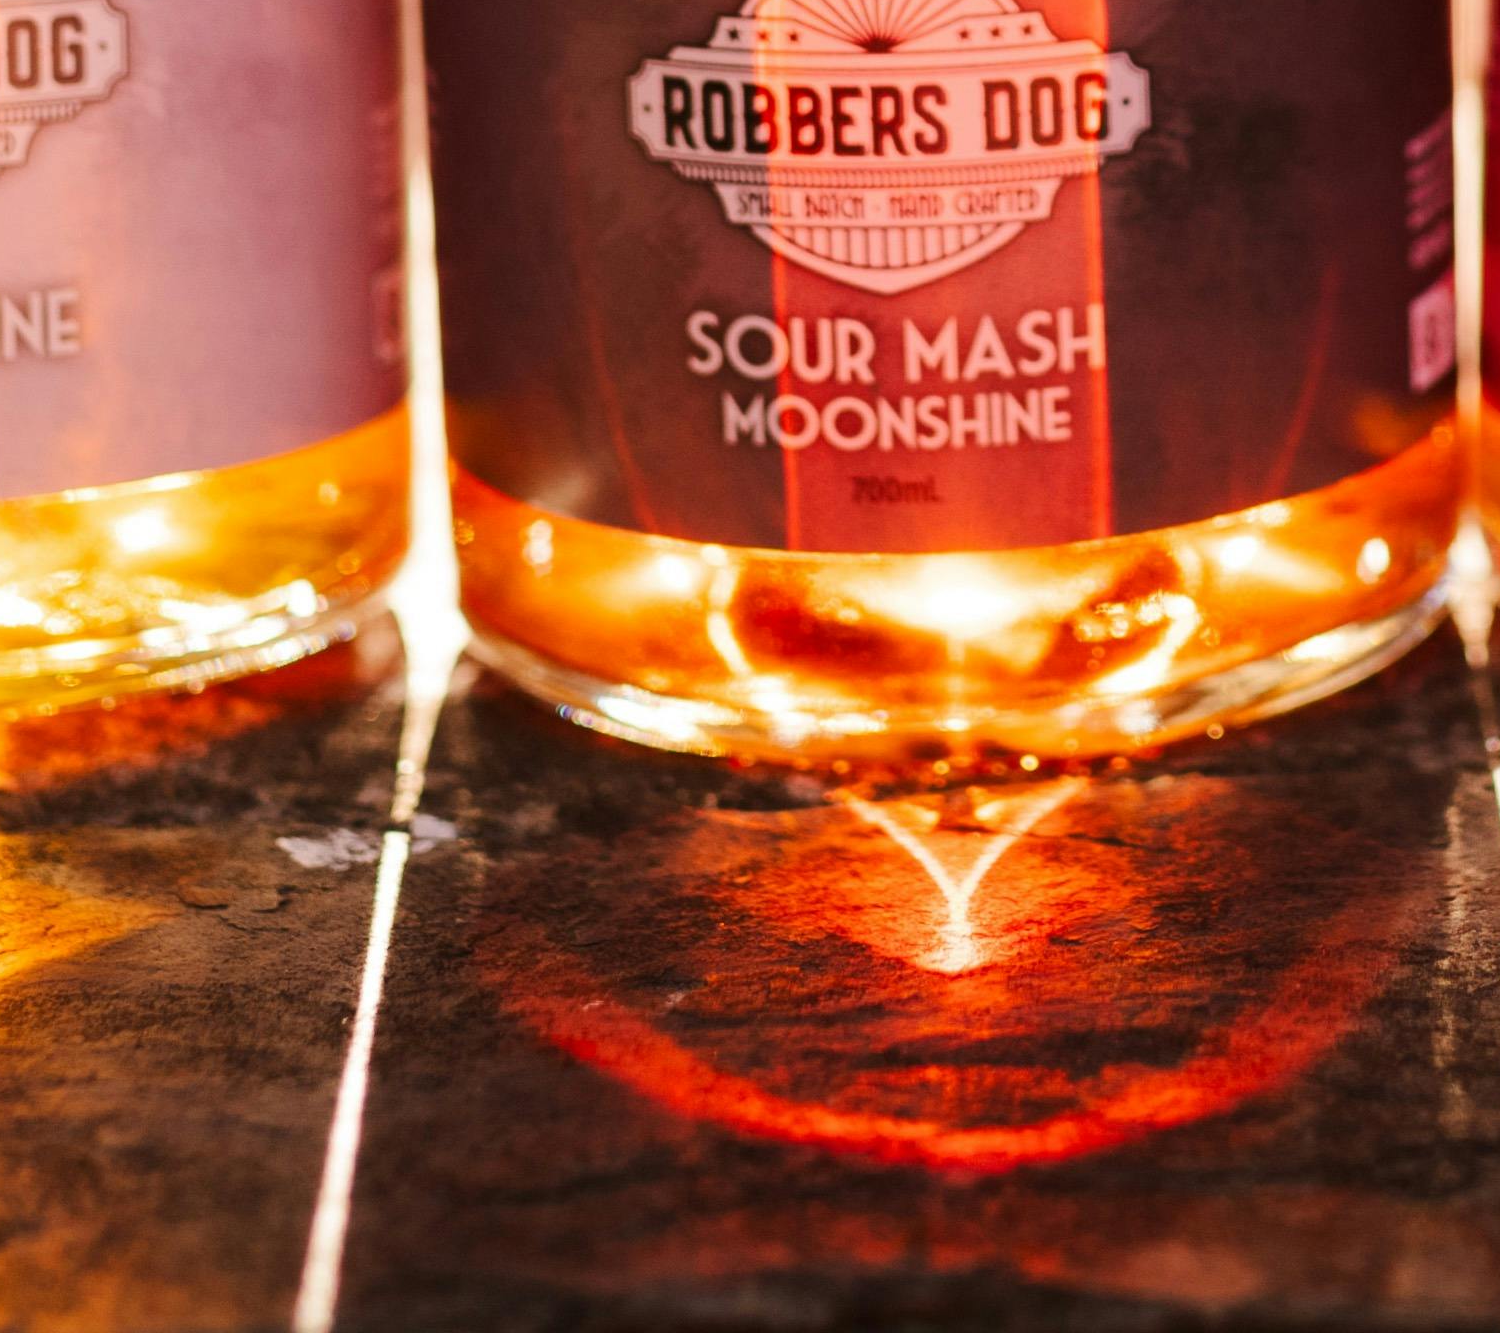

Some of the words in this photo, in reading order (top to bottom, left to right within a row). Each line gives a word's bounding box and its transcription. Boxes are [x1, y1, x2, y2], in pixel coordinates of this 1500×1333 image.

[661, 73, 950, 157] ROBBERS
[982, 70, 1109, 151] DOG
[738, 191, 793, 219] SMALL
[805, 193, 865, 219] BATCH
[889, 192, 945, 218] HAND
[954, 188, 1041, 216] CRAFTED
[686, 309, 877, 385] SOUR
[902, 302, 1106, 384] MASH
[720, 384, 1073, 452] MOONSHINE
[850, 474, 941, 504] 700mL
